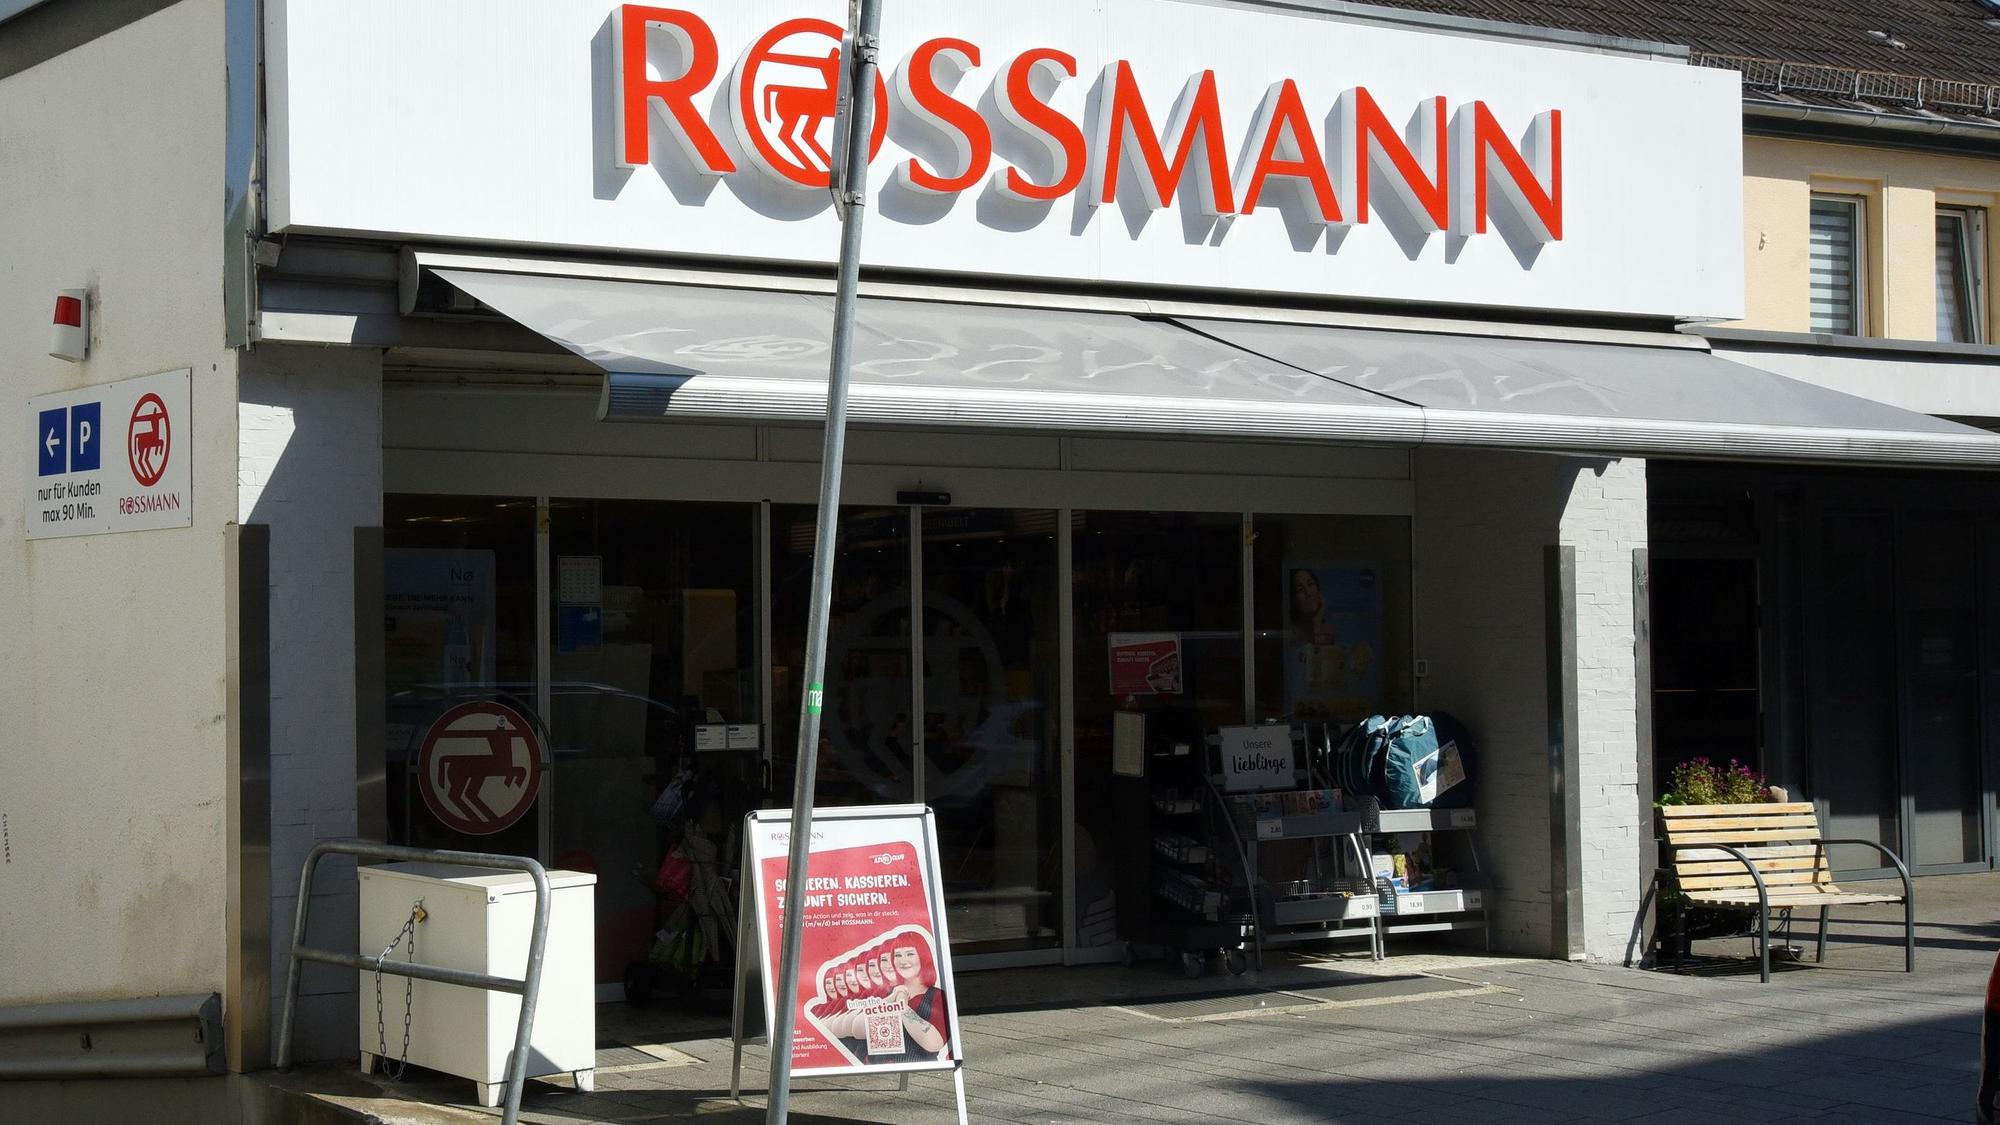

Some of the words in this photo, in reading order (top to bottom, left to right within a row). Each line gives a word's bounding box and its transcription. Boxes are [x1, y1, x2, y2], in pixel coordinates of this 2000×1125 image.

[614, 4, 1563, 243] ROSSMANN
[79, 421, 91, 455] P
[38, 487, 52, 502] nur
[53, 484, 66, 499] für
[67, 480, 101, 498] Kunden
[42, 506, 60, 523] max
[62, 505, 75, 521] 90
[76, 503, 96, 519] Min.
[119, 492, 180, 515] ROSSMANN
[1242, 740, 1273, 750] Unsere
[1232, 752, 1287, 774] Lieblinge
[771, 831, 824, 841] ROSNN
[775, 877, 842, 892] SCIEREN.
[845, 874, 911, 889] KASSIEREN.
[776, 894, 834, 909] ZUNFT
[837, 892, 891, 906] SICHERN.
[806, 920, 831, 929] (m/w/d)
[865, 1001, 904, 1015] action!
